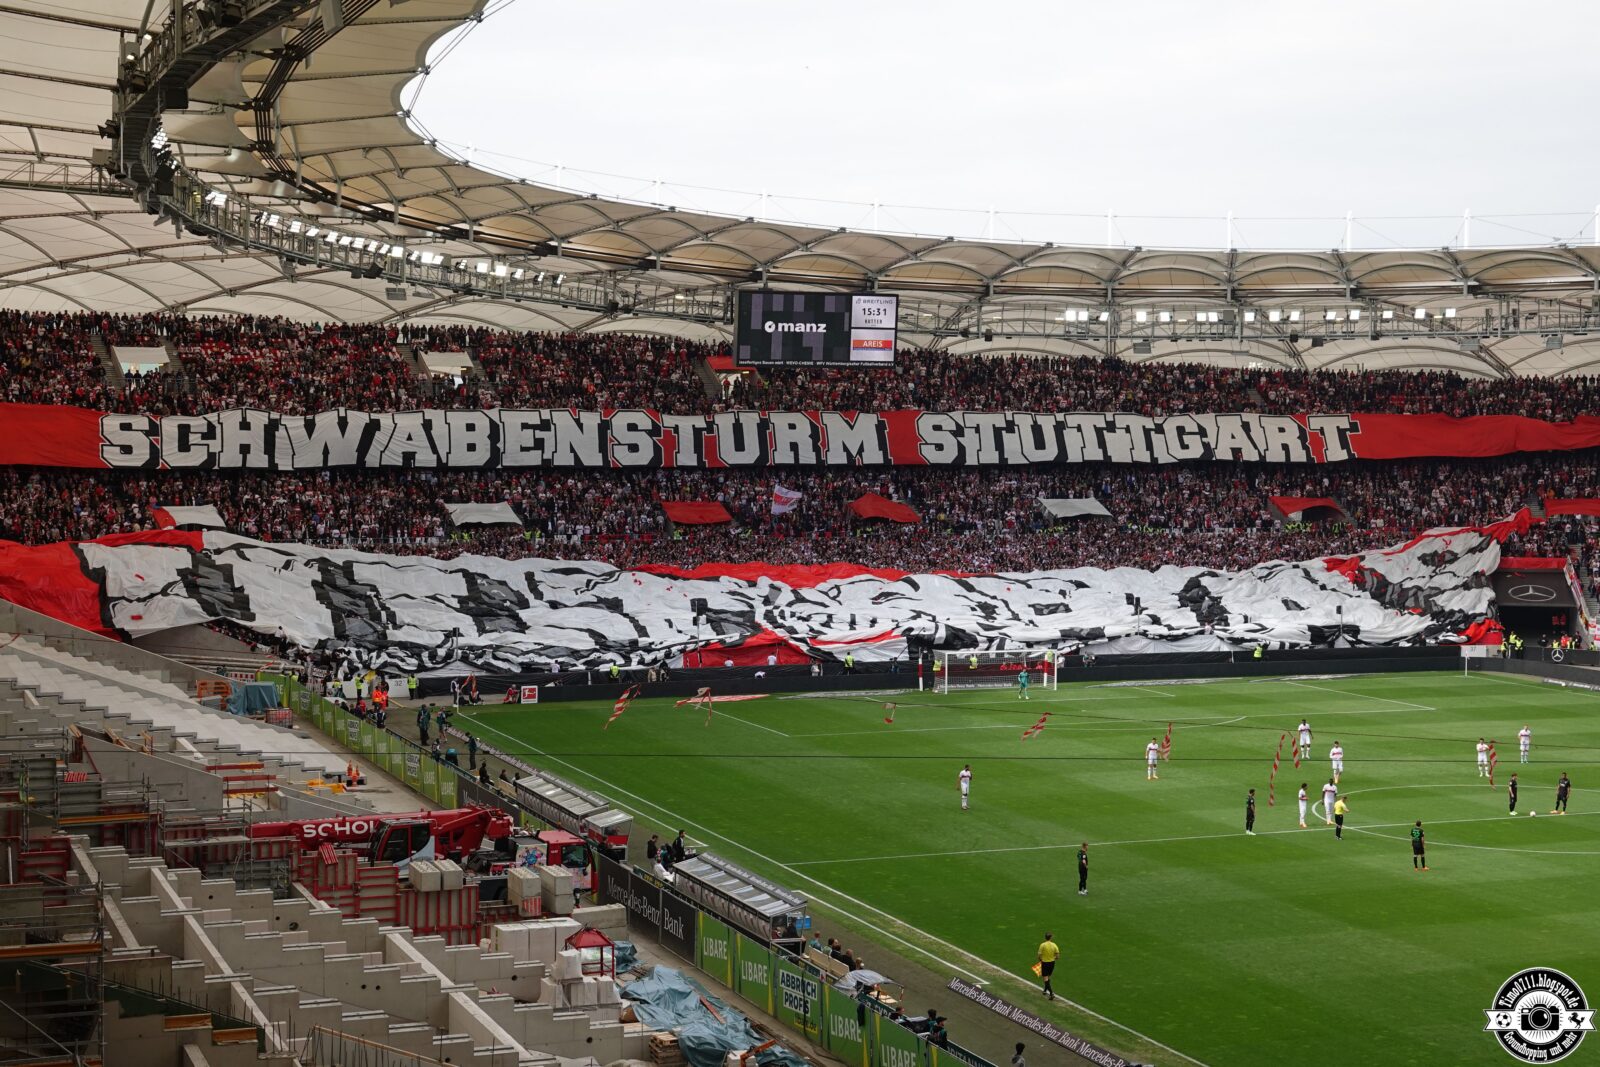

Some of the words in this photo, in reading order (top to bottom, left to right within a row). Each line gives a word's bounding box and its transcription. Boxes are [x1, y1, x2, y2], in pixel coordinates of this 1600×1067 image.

[862, 307, 887, 316] 15:31
[777, 322, 827, 333] manz
[862, 340, 883, 348] AREIS
[100, 406, 892, 470] SCHWABENSTURM
[917, 410, 1360, 466] STUTTGART
[607, 874, 661, 927] Mercedes-Benz
[663, 907, 685, 941] Bank
[703, 936, 728, 961] LIBARE
[741, 960, 768, 986] LIBARE
[780, 971, 817, 999] ABBRUCH
[948, 976, 995, 1008] Mercedes-Benz
[992, 998, 1012, 1018] Bank
[1009, 1006, 1061, 1041] Mercedes-Benz
[1058, 1031, 1081, 1051] Bank
[830, 1014, 862, 1043] LIBARE
